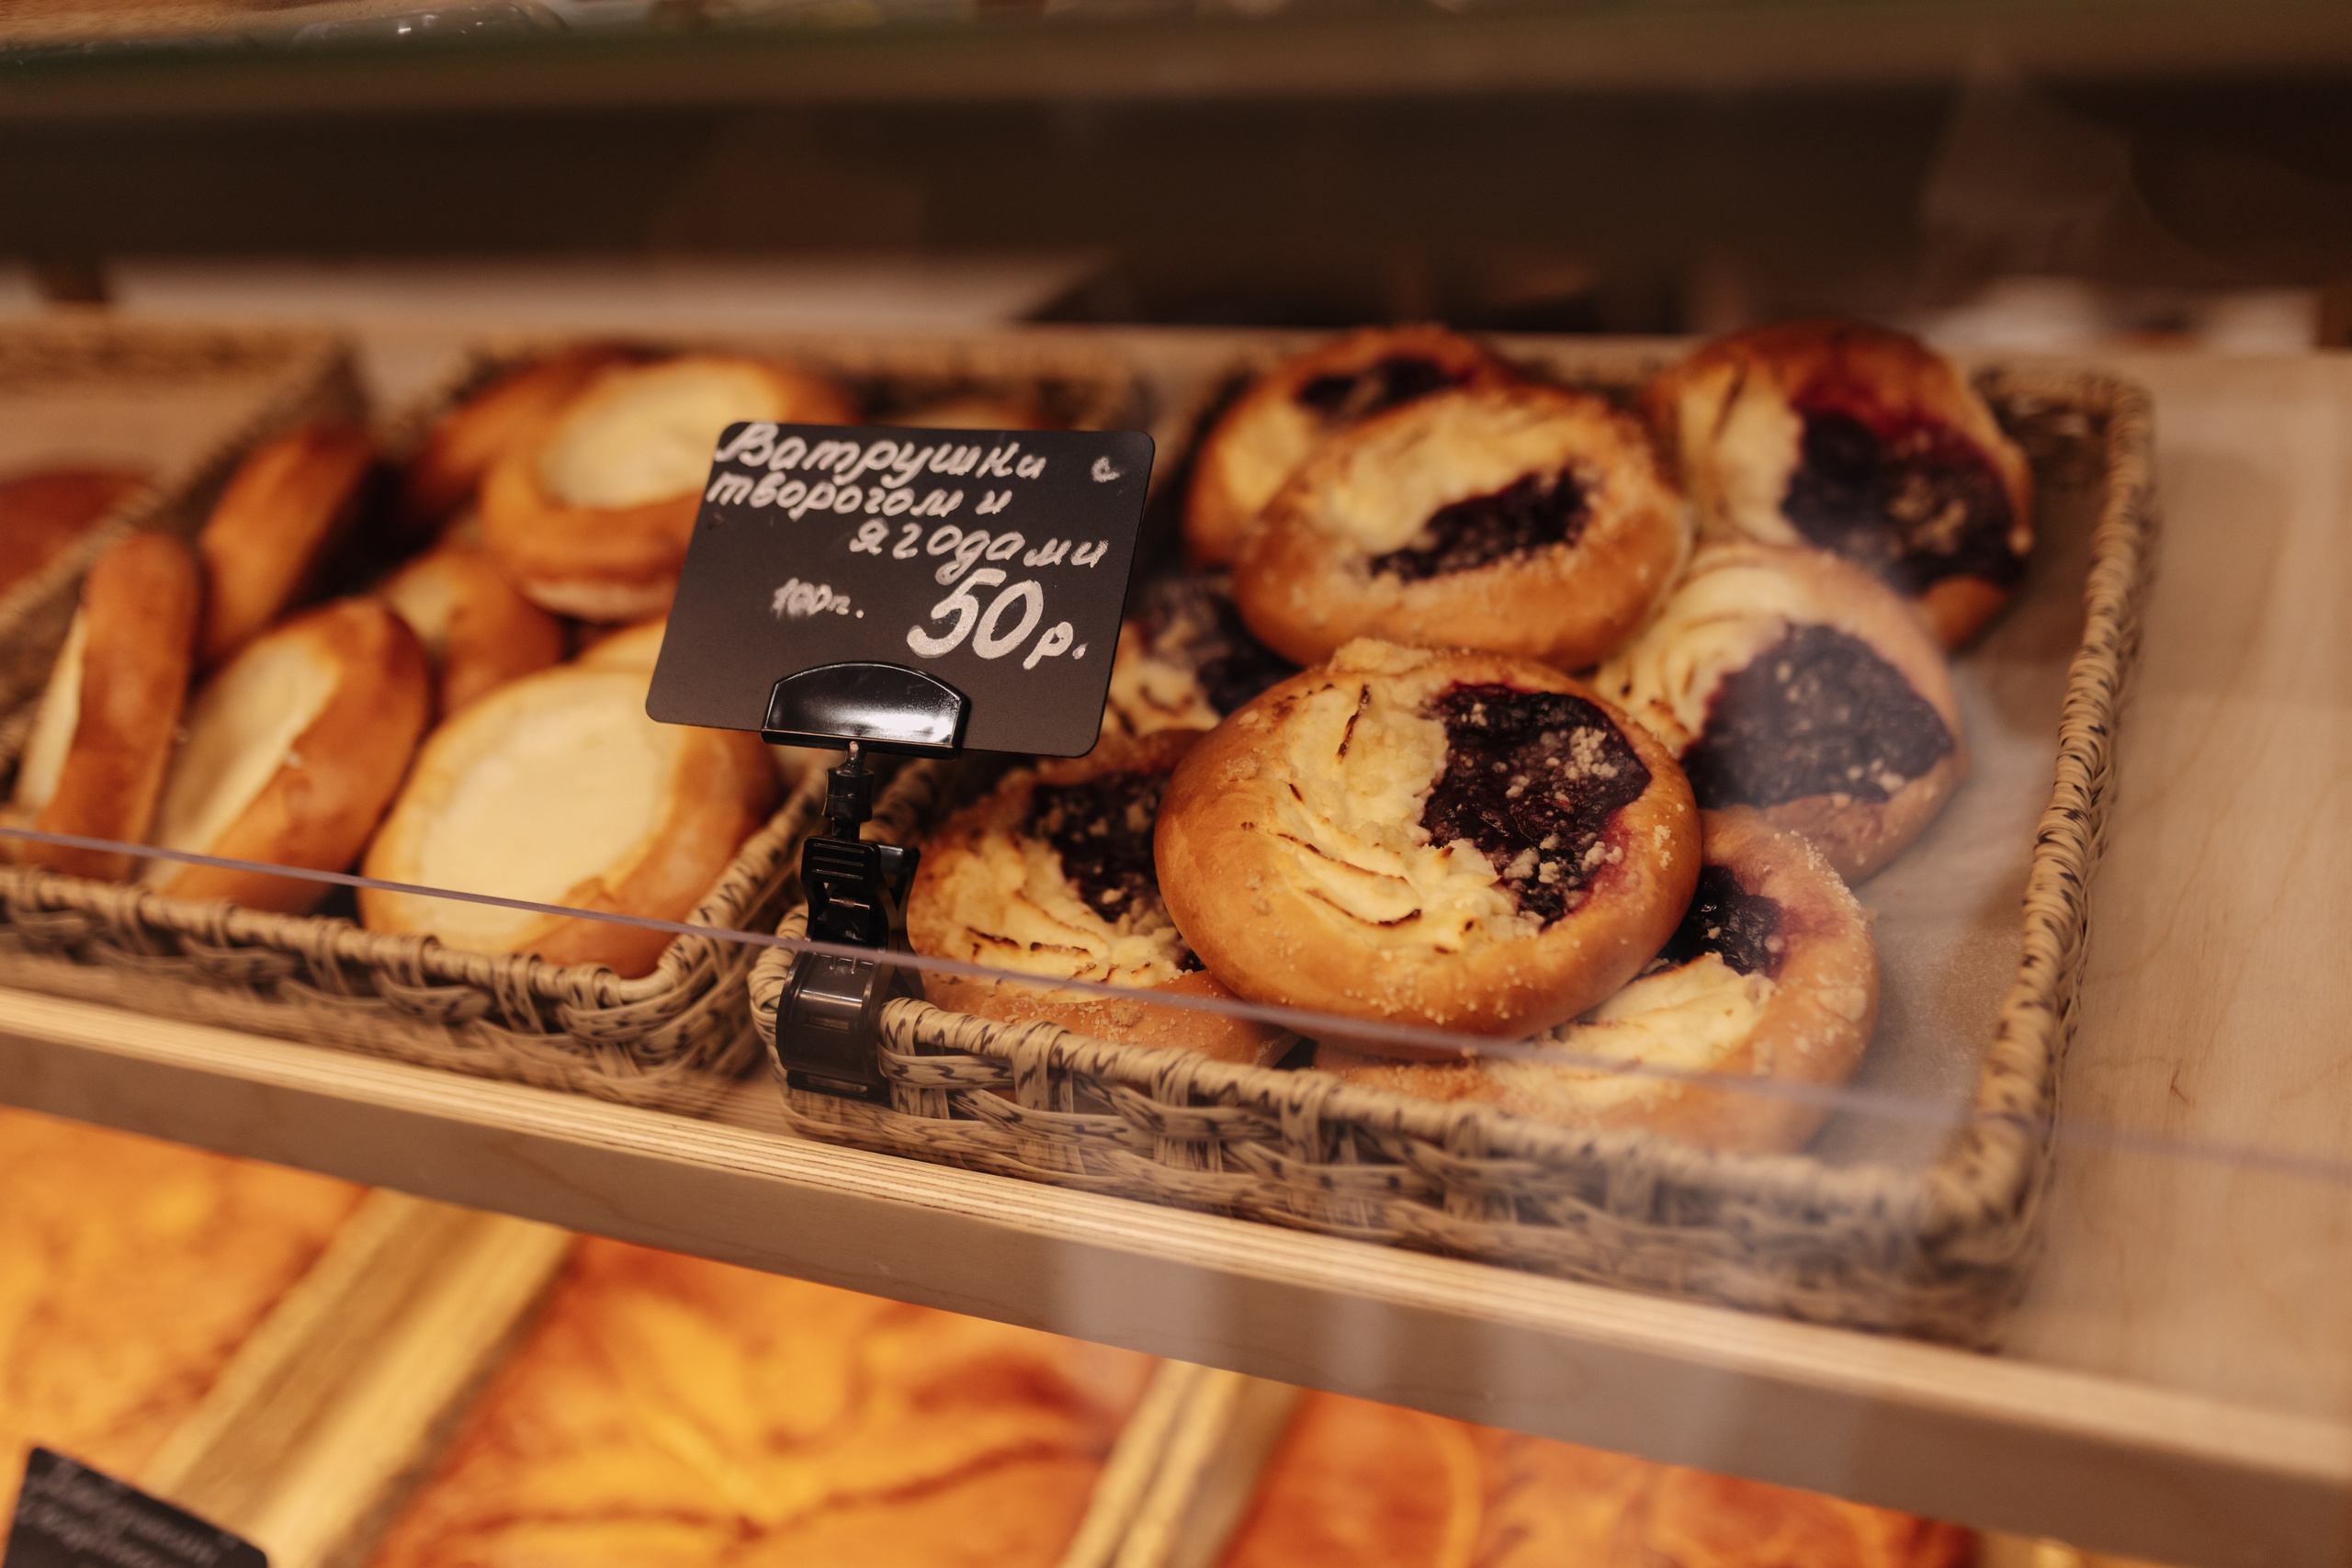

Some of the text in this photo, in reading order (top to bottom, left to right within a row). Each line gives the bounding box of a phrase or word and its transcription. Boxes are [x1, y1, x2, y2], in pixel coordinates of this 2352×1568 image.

[714, 422, 1046, 489] Ватрушки
[706, 470, 1012, 523] творогом и
[849, 517, 1109, 586] ягодами
[906, 567, 1089, 671] 50р.
